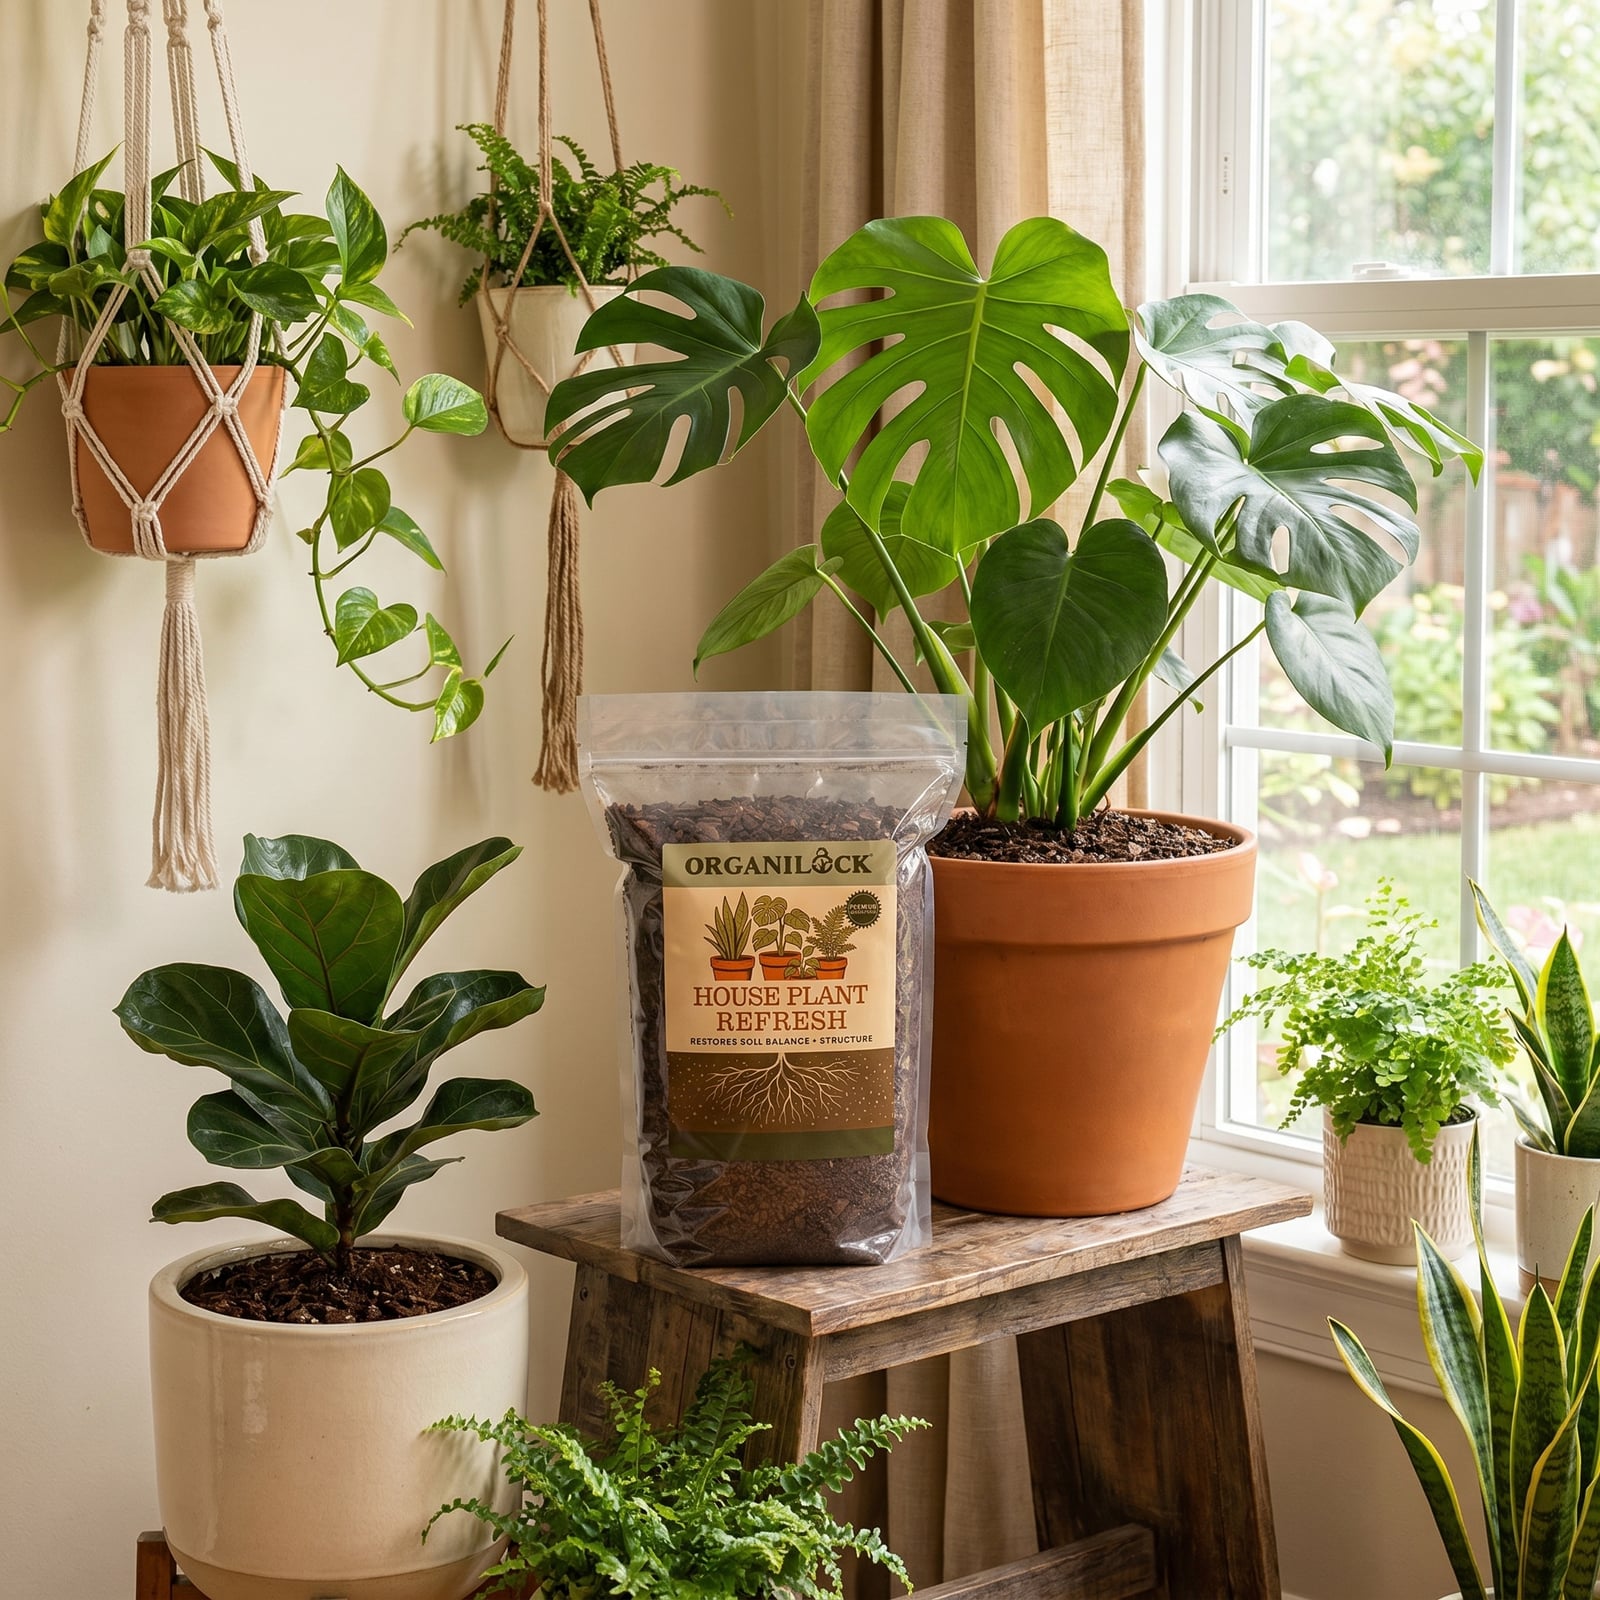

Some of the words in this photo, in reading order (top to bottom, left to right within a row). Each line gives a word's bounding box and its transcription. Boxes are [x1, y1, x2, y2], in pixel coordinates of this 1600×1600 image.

[685, 847, 872, 875] ORGANILOCK
[693, 986, 780, 1007] HOUSE
[787, 985, 868, 1005] PLANT
[716, 1010, 847, 1032] REFRESH
[690, 1038, 738, 1047] RESTORES
[765, 1037, 810, 1046] BALANCE
[819, 1035, 873, 1044] STRUCTURE
